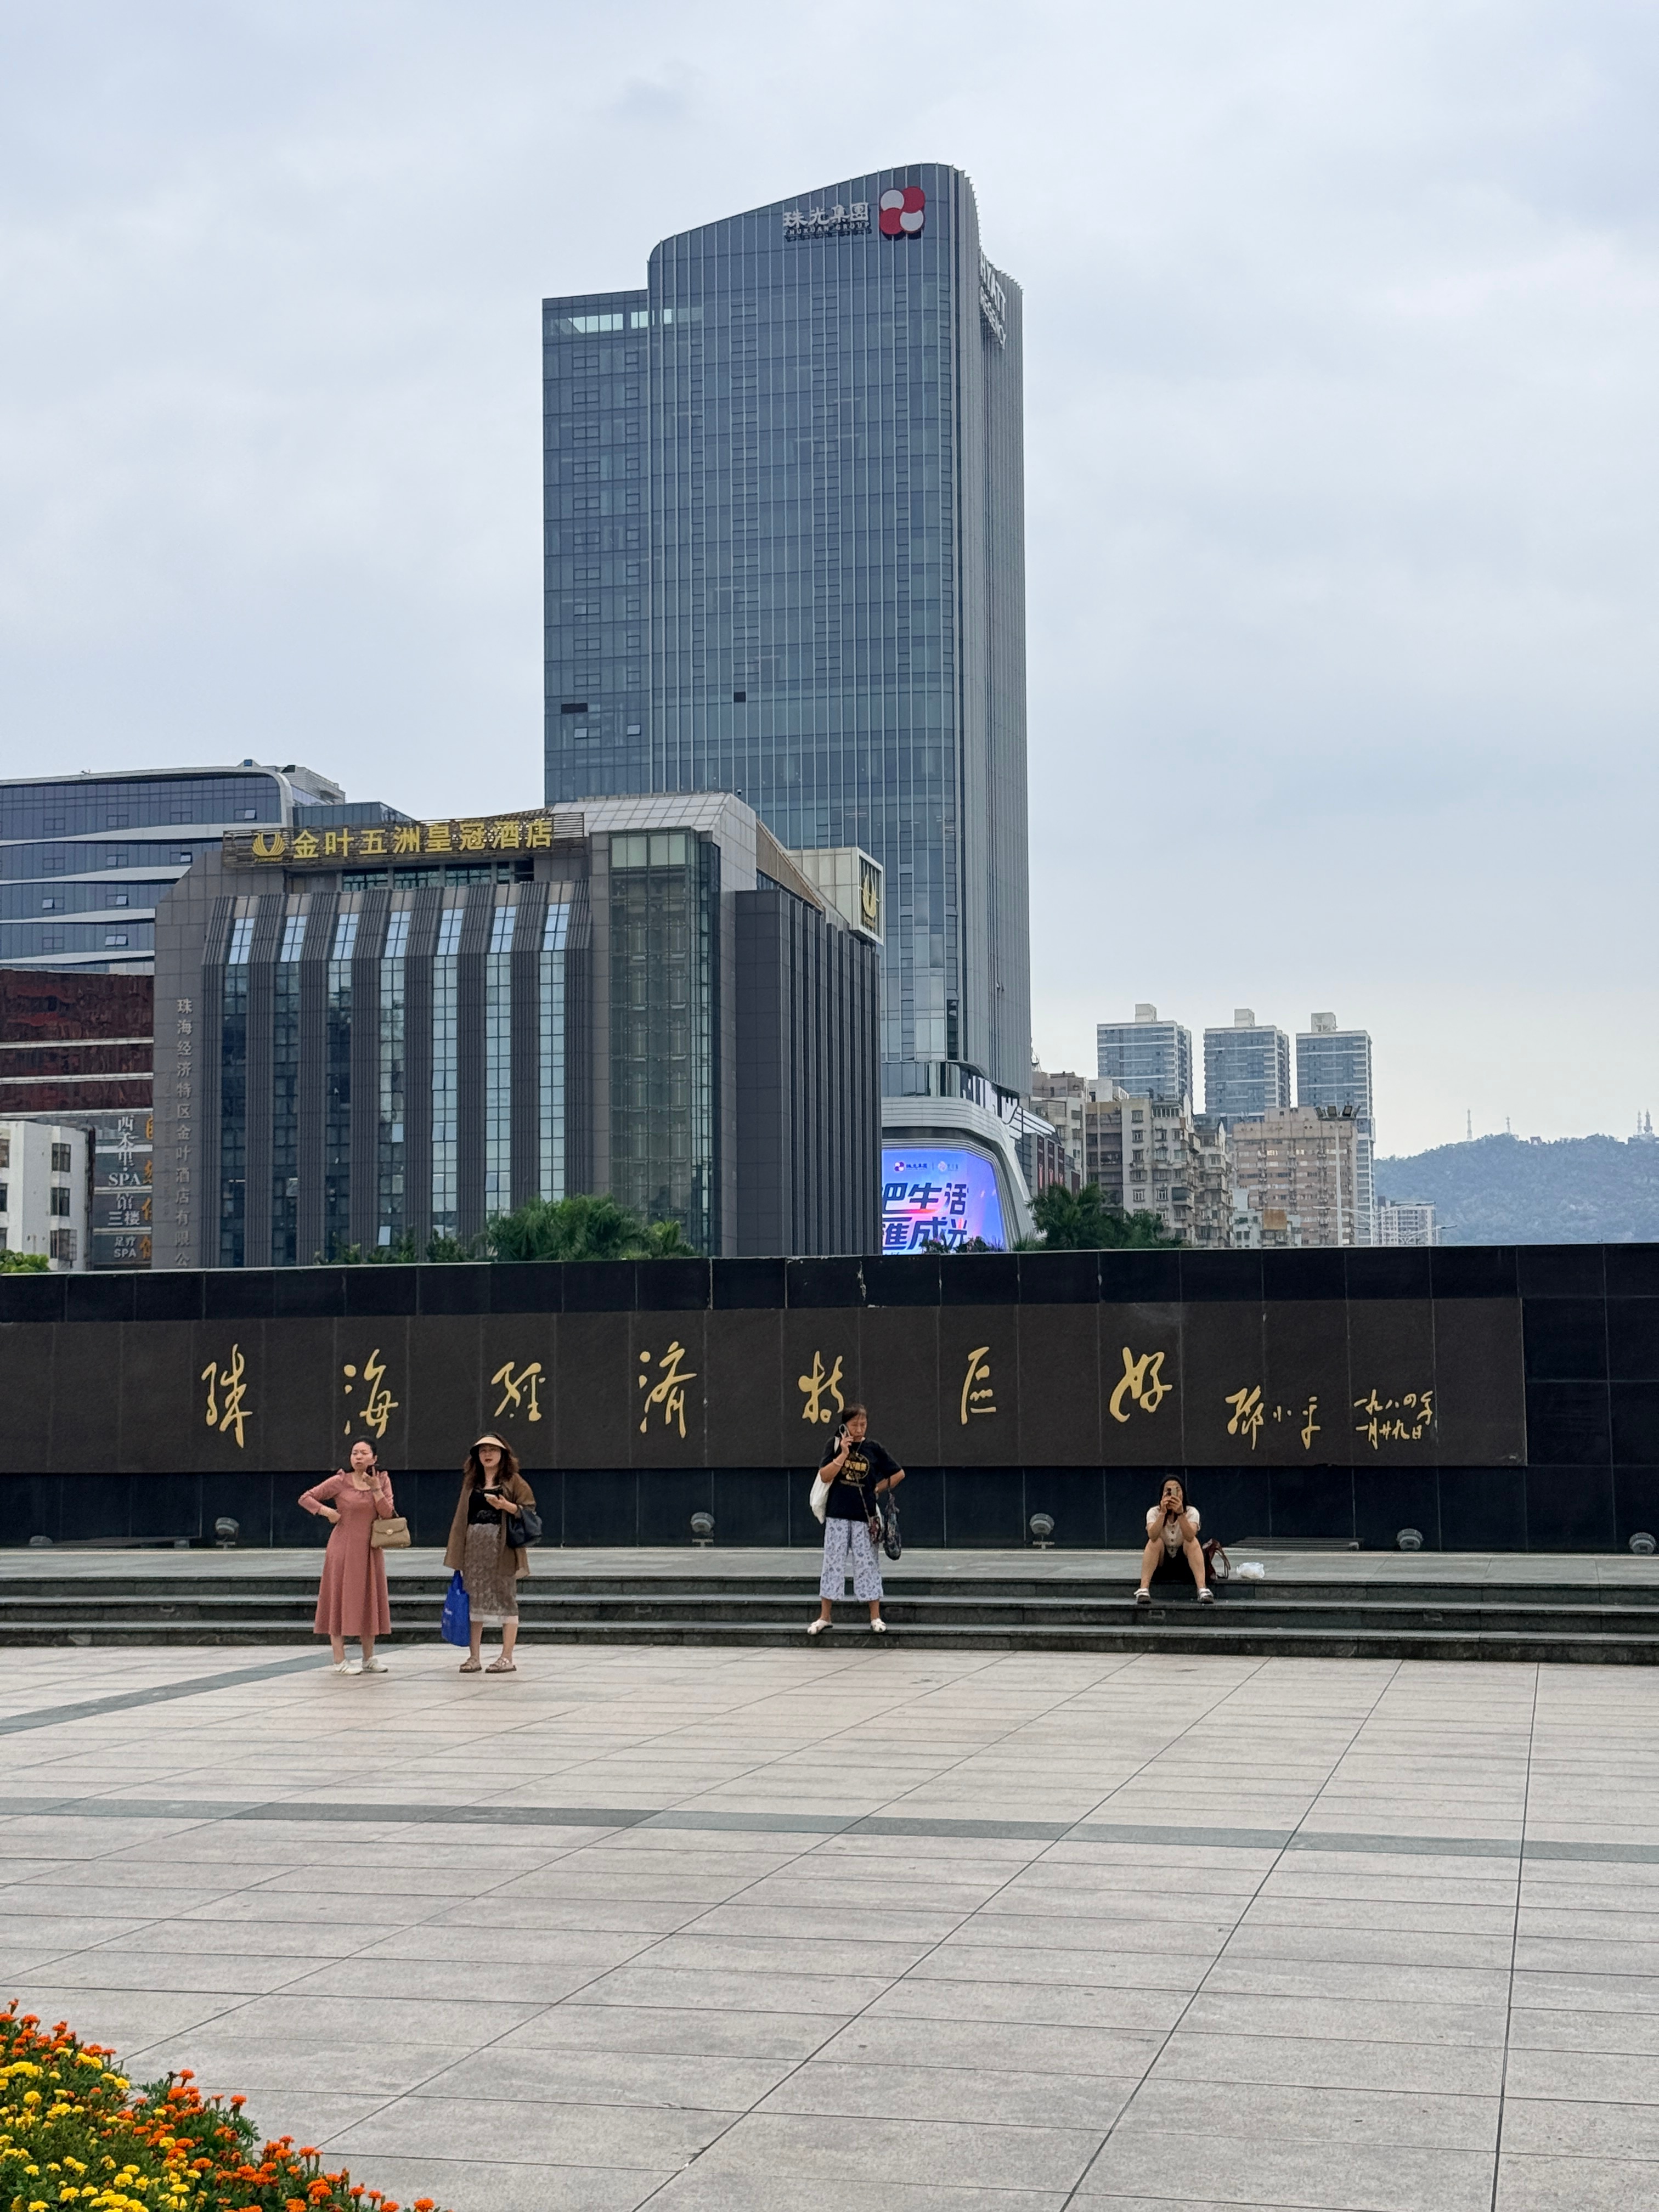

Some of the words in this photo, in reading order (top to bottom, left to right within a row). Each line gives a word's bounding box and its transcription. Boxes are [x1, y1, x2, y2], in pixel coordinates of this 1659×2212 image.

[835, 222, 870, 231] GROUP
[292, 817, 554, 860] 金叶五洲皇冠酒店
[108, 1172, 141, 1186] SPA
[114, 1249, 136, 1258] SPA
